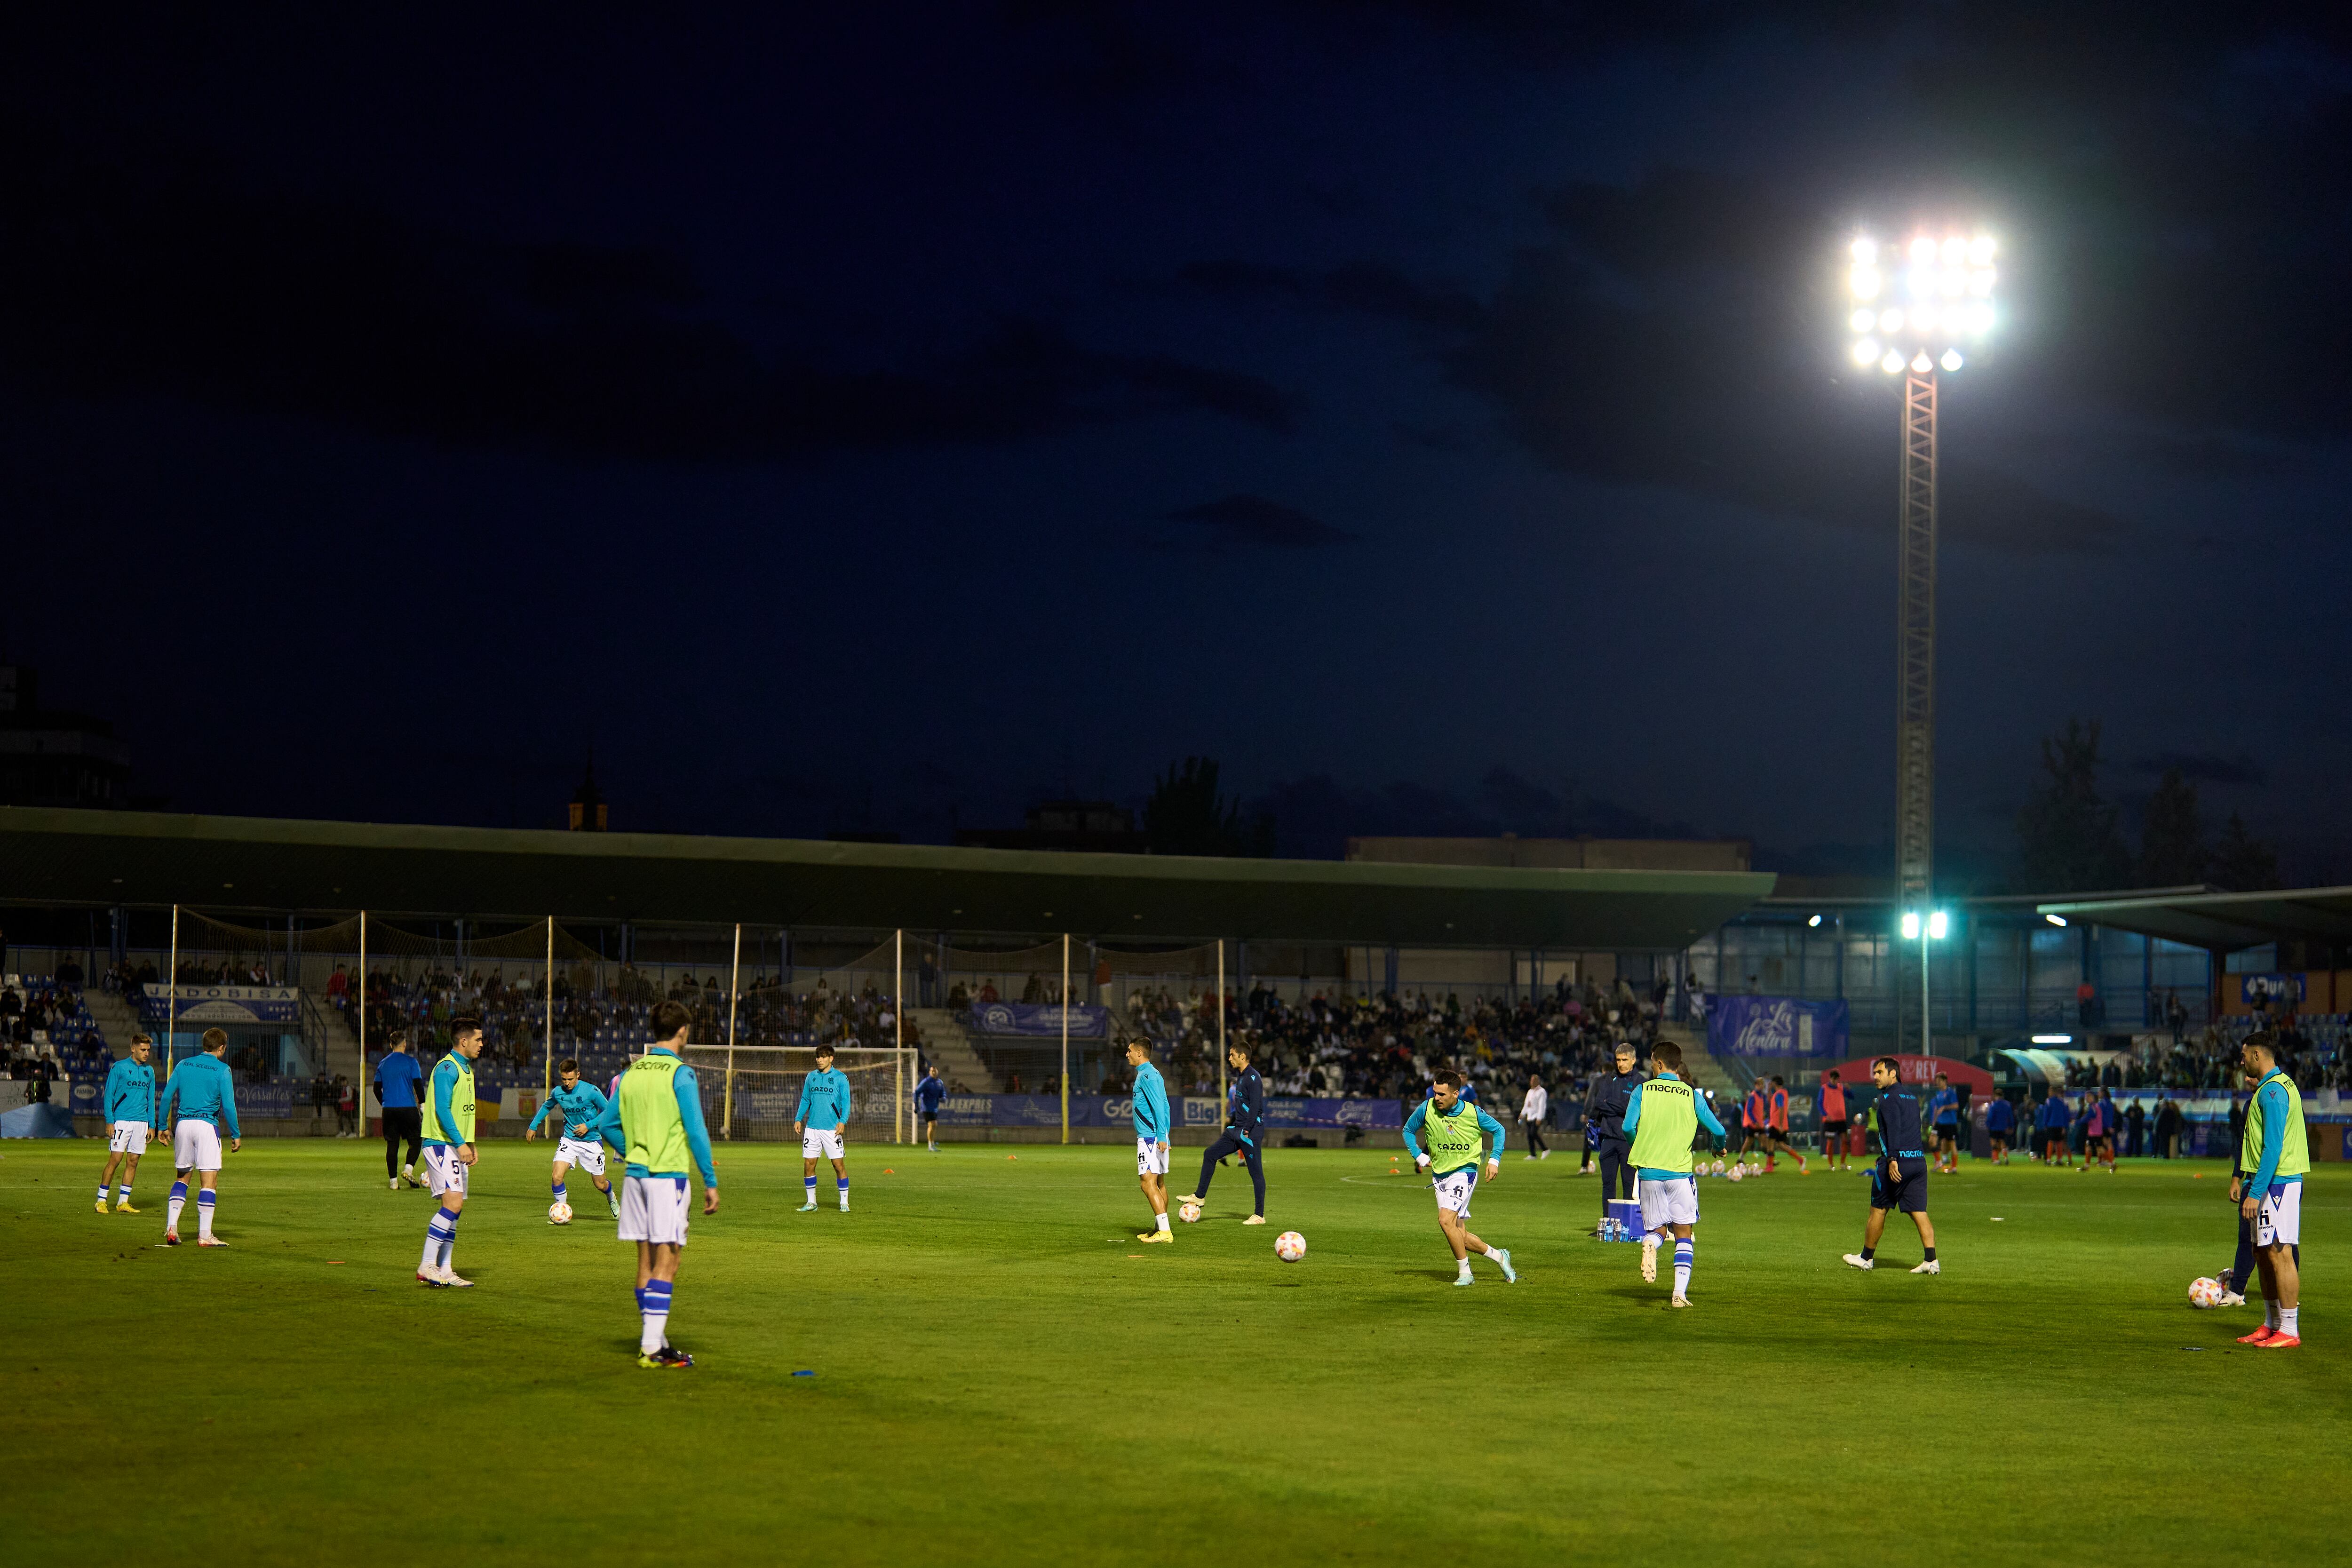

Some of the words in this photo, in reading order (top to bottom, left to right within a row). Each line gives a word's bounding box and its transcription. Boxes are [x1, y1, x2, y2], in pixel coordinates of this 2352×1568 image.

[150, 986, 290, 998] JADOBISA
[1915, 1061, 1938, 1079] REY
[236, 1086, 290, 1105] Versalles
[1646, 1084, 1690, 1097] macron
[113, 1130, 123, 1140] 17
[1138, 1152, 1145, 1162] fi
[452, 1160, 460, 1175] 5
[1453, 1186, 1463, 1198] fi
